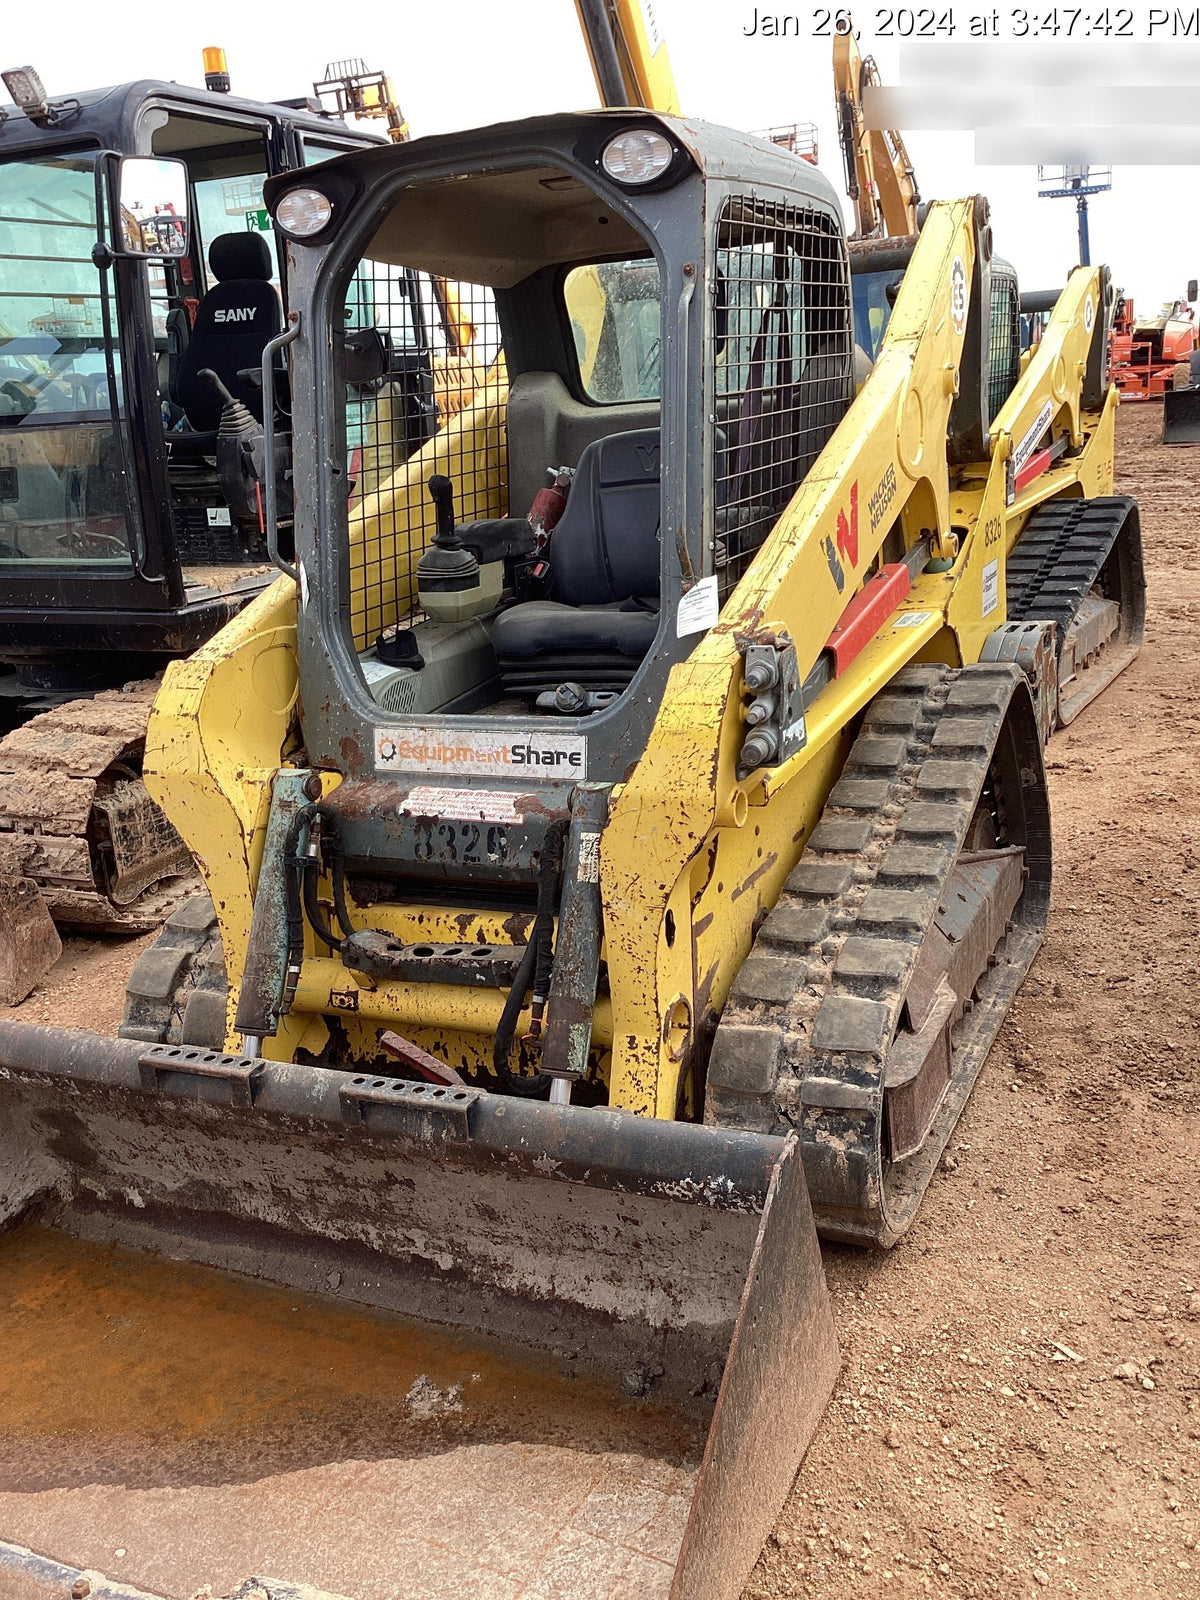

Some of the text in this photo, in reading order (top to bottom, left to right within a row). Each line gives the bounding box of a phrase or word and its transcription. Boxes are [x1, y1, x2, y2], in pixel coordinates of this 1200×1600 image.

[214, 306, 257, 322] SANY
[868, 462, 895, 516] WACKER
[870, 476, 897, 535] NEUSON
[985, 514, 1002, 548] 8326
[399, 740, 582, 767] EquipmentShare
[437, 789, 474, 798] CUSTOMER
